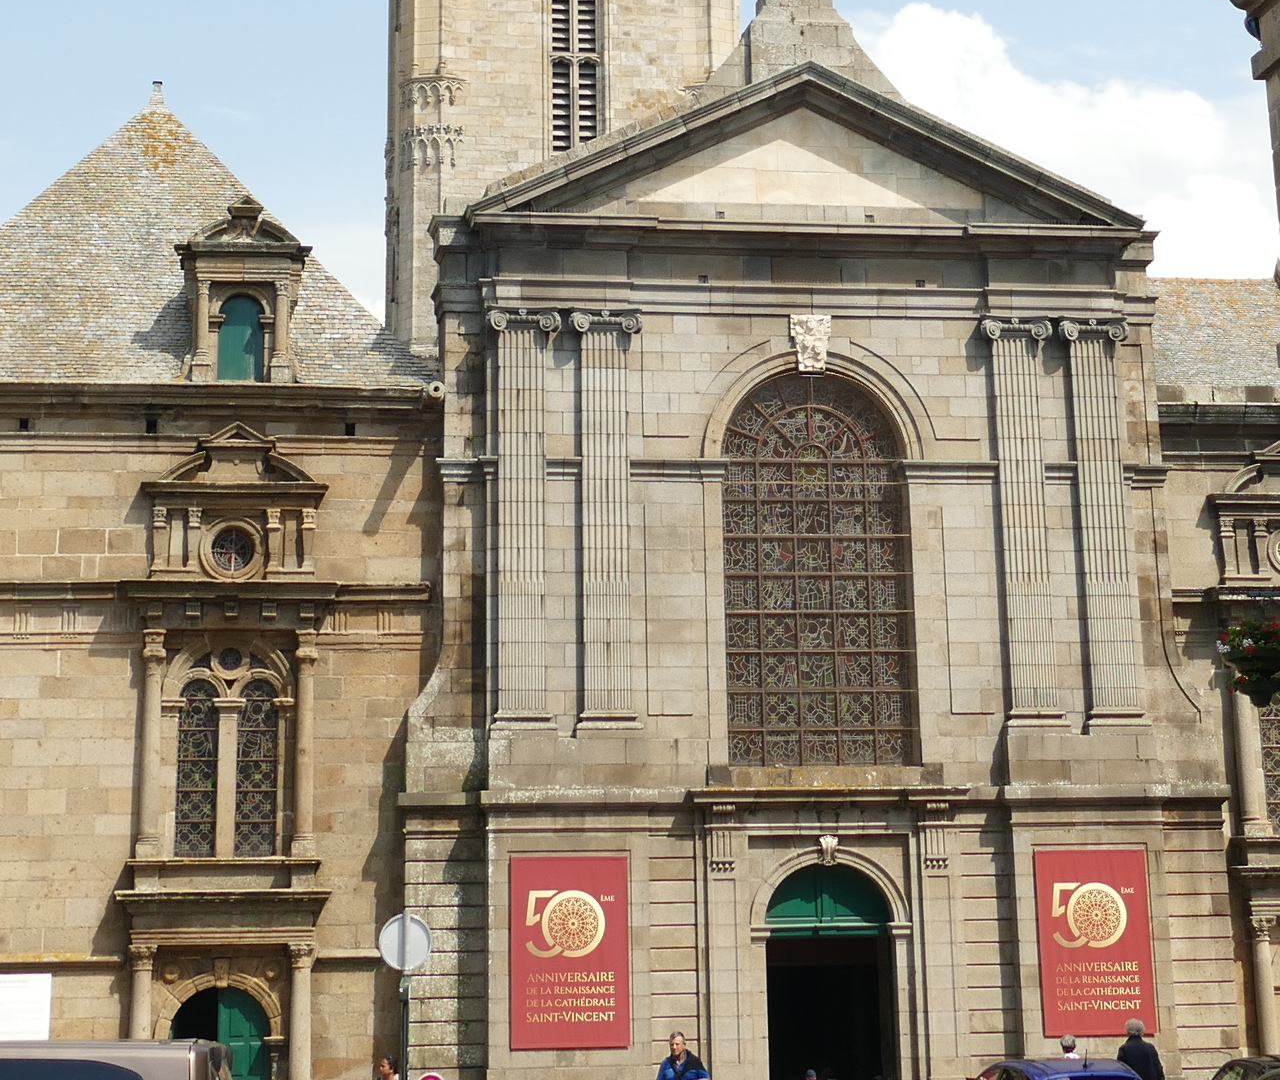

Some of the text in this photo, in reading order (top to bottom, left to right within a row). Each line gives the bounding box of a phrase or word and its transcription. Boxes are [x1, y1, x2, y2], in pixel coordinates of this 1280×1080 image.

[1052, 882, 1127, 948] 50
[525, 890, 606, 958] 50
[1056, 961, 1139, 972] ANNIVERSAIRE
[527, 971, 615, 983] ANNIVERSAIRE
[1056, 974, 1140, 984] DE LA RENAISSANCE
[526, 985, 615, 995] DE LA RENAISSANCE
[1057, 985, 1141, 996] DE LA CATHÉDRALE
[526, 997, 616, 1007] DE LA CATHÉDRALE
[1057, 1000, 1142, 1011] SAINT-VINCENT
[526, 1011, 616, 1023] SAINT-VINCENT
